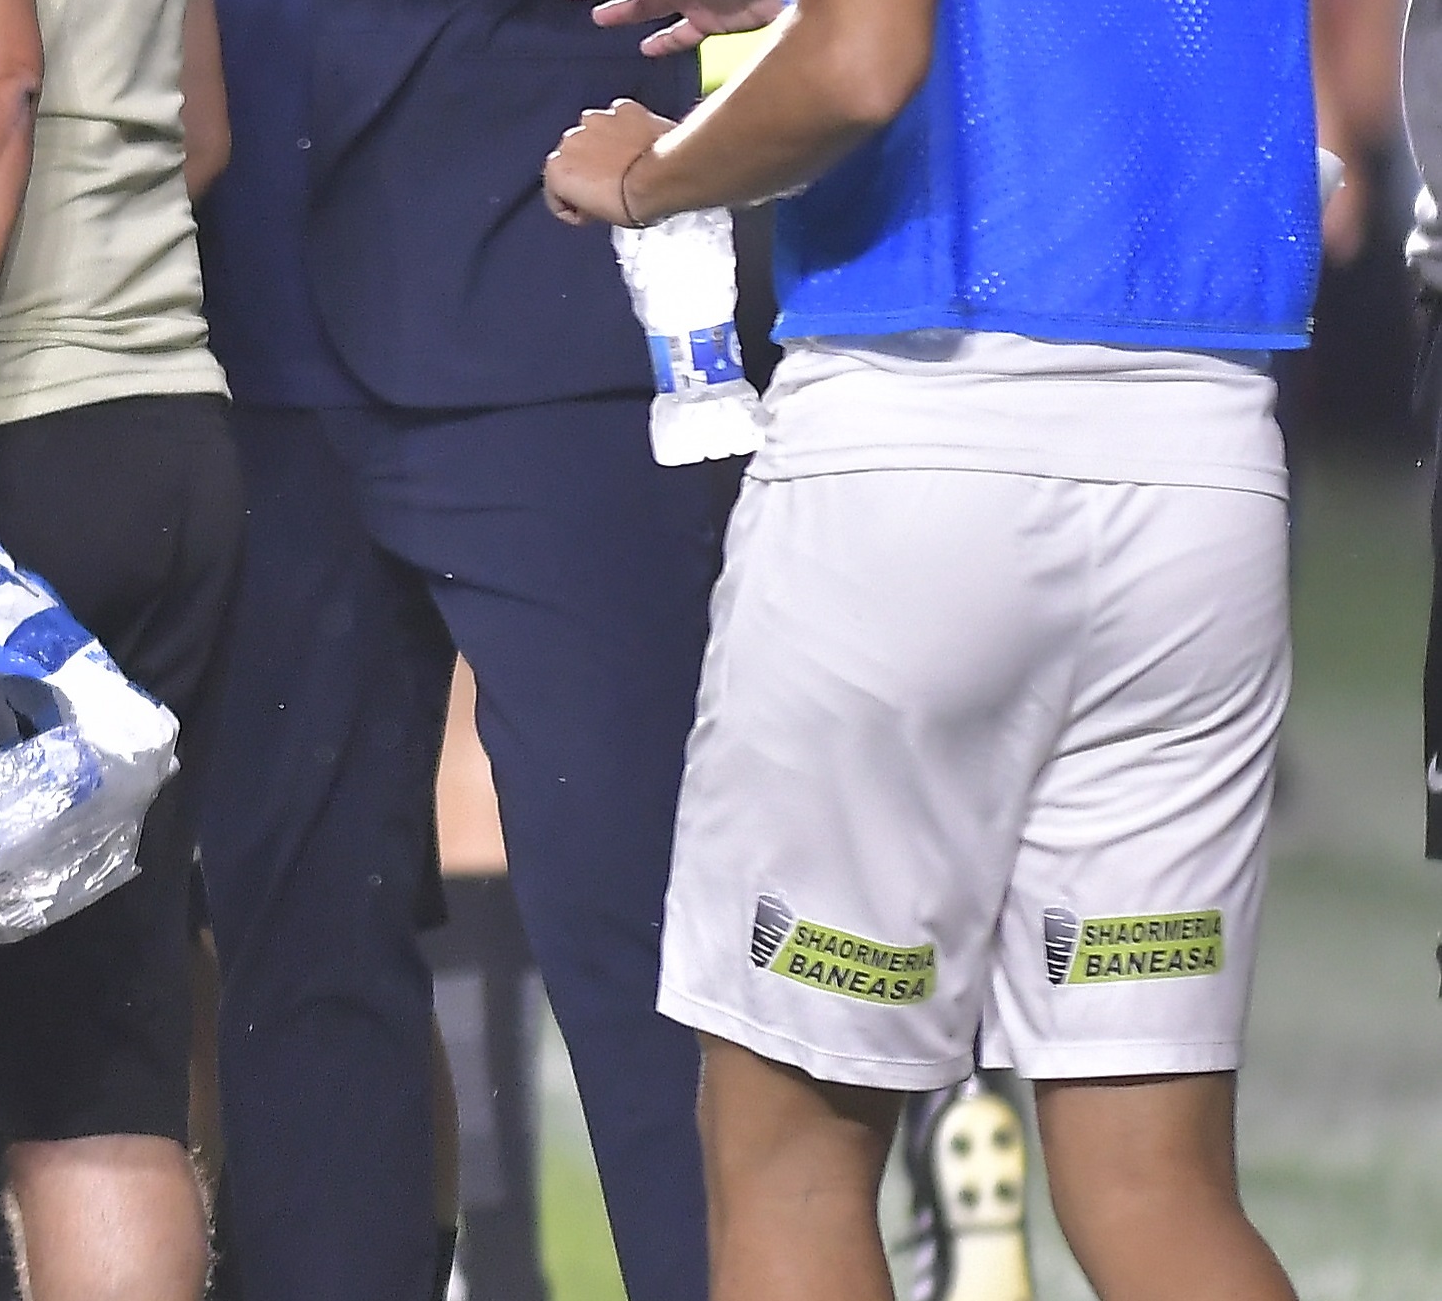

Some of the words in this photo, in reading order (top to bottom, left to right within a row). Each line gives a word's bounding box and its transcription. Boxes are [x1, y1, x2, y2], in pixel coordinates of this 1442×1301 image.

[794, 926, 935, 972] SHAORMERIA
[1084, 915, 1222, 947] SHAORMERIA
[788, 953, 926, 1000] BANEASA
[1085, 945, 1218, 978] BANEASA
